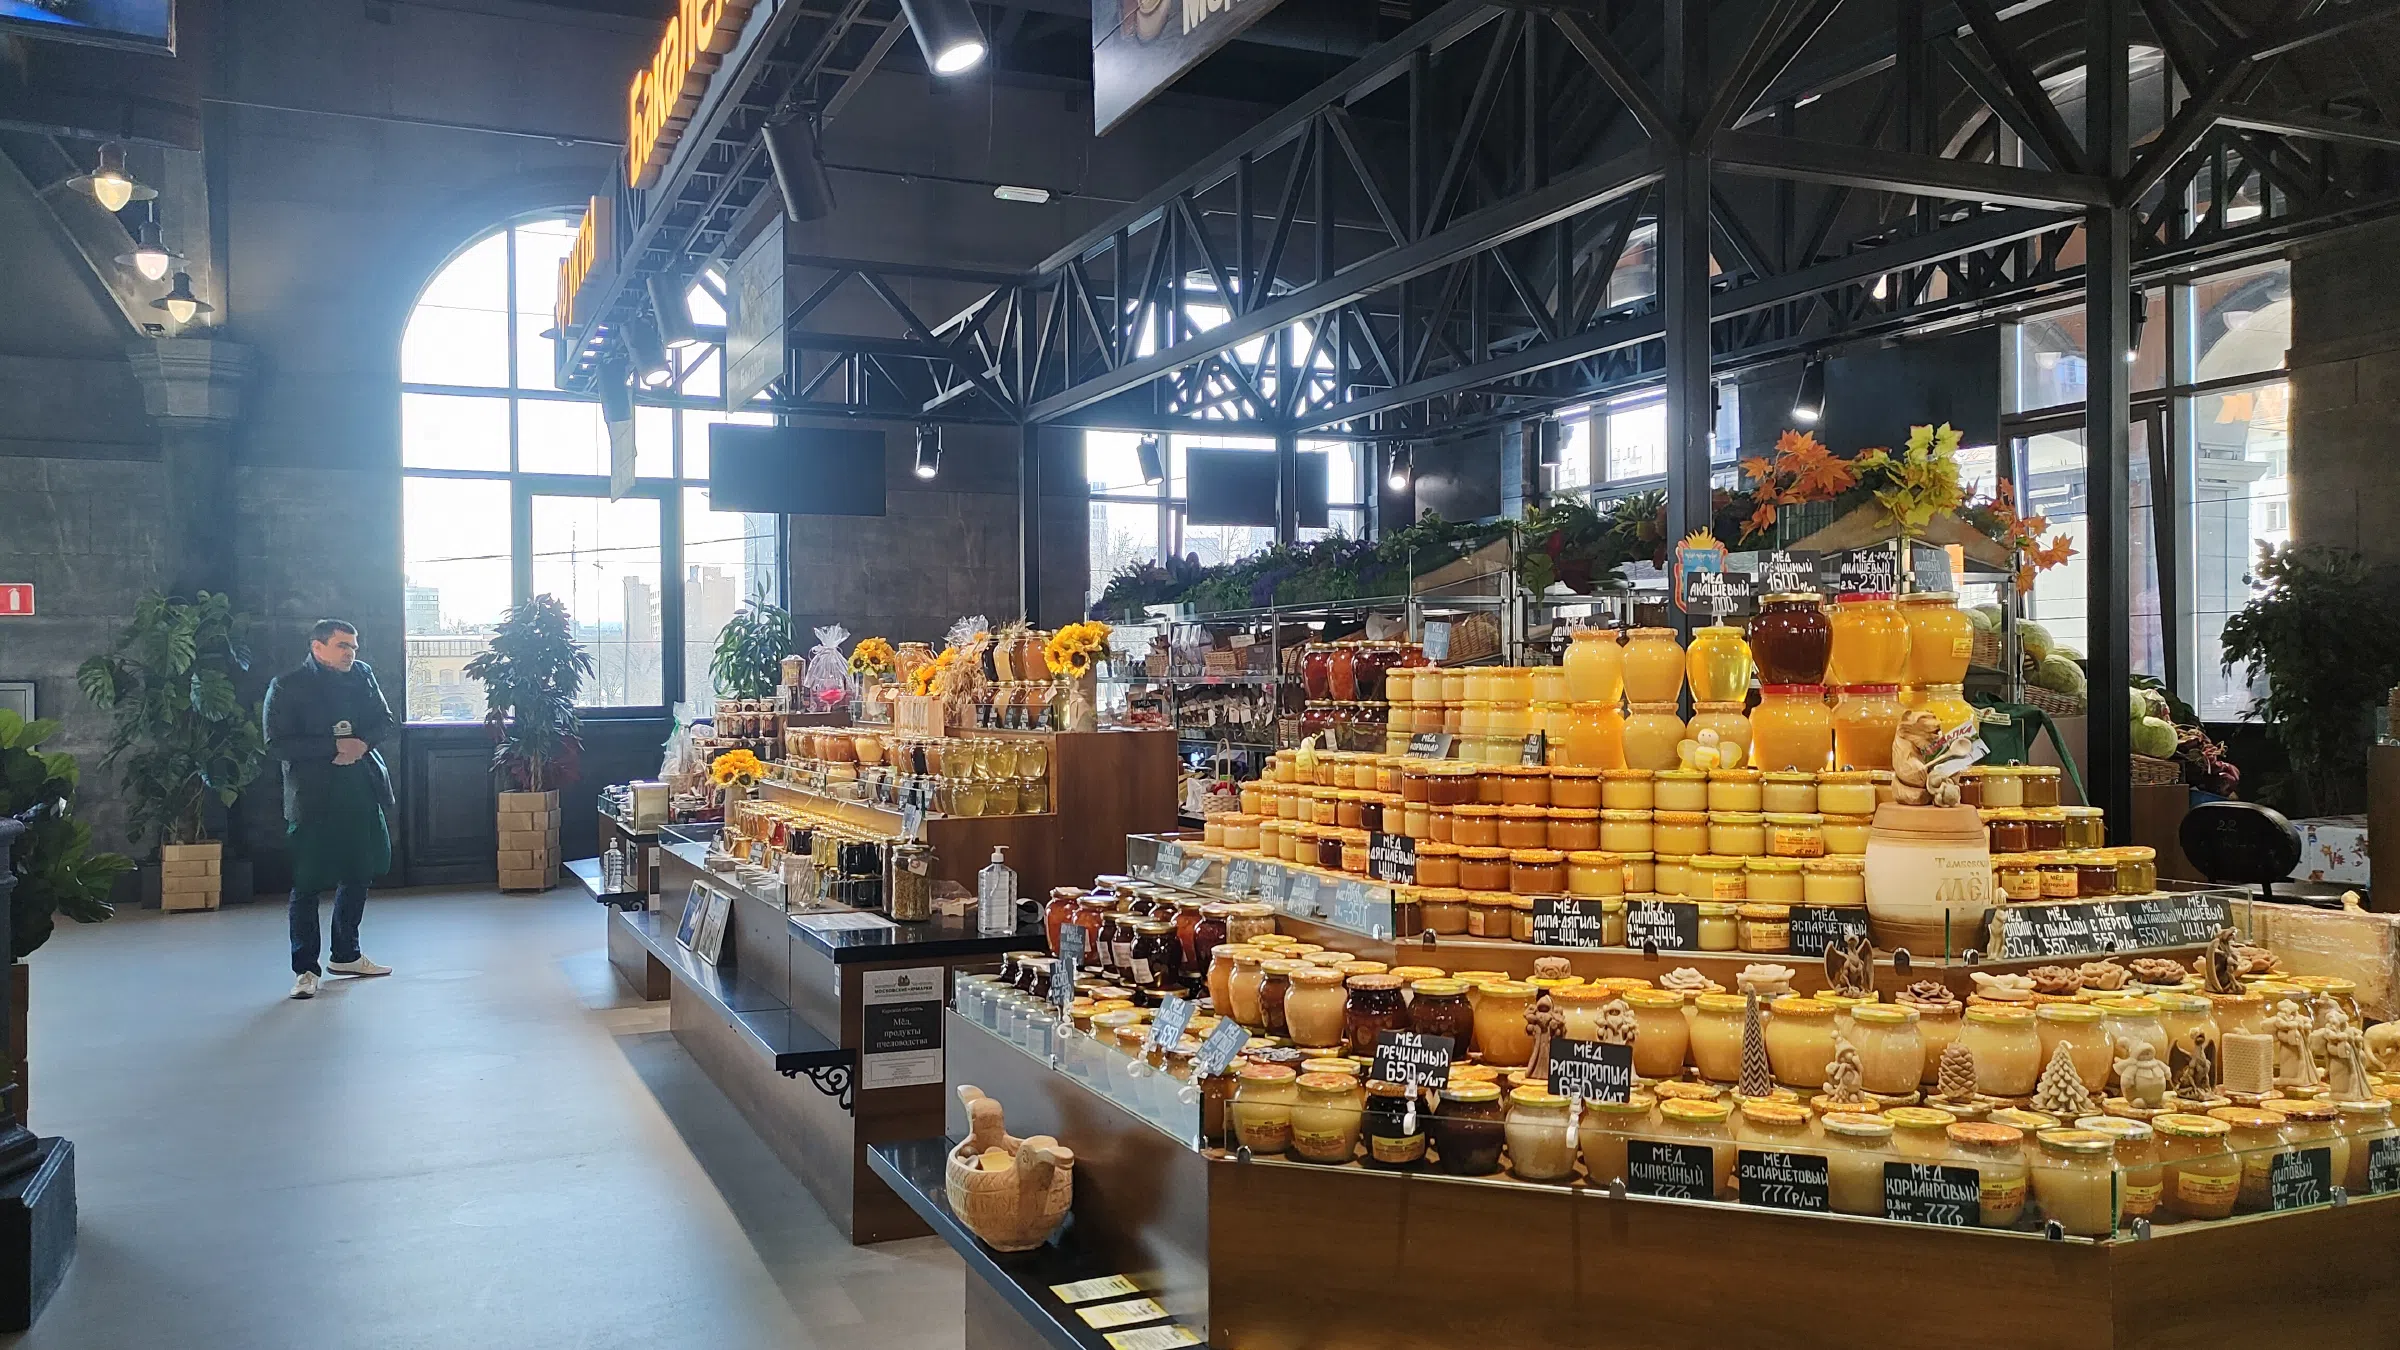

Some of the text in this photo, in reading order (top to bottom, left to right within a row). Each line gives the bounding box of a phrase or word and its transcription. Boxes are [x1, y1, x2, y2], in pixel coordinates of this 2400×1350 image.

[1771, 550, 1791, 563] МЁД
[1701, 572, 1724, 584] МЁД
[1383, 834, 1401, 849] МЁД
[1370, 847, 1415, 866] ДЯГИЛЕВЫЙ
[1553, 898, 1581, 914] МЁД
[2093, 902, 2115, 917] МЁД
[2141, 901, 2160, 913] МЁД
[2187, 895, 2209, 908] МЁД
[1627, 909, 1675, 926] ЛИПОВЫЙ
[1812, 907, 1838, 922] МЁД
[2046, 906, 2071, 922] МЁД
[884, 1028, 921, 1039] продукты
[1395, 1032, 1422, 1048] МЁД
[876, 1038, 928, 1048] пчеловодства
[1573, 1041, 1603, 1061] МЁД
[1376, 1045, 1449, 1068] ГРЕЧИШНЫЙ
[1550, 1058, 1629, 1087] РАСТОРОПША
[1652, 1144, 1686, 1166] МЁД
[1630, 1162, 1704, 1187] КИПРЕЙНЫЙ
[1741, 1165, 1829, 1187] ЭСПАРЦЕТОВЫЙ
[2272, 1158, 2313, 1184] ЛИПОВЫЙ
